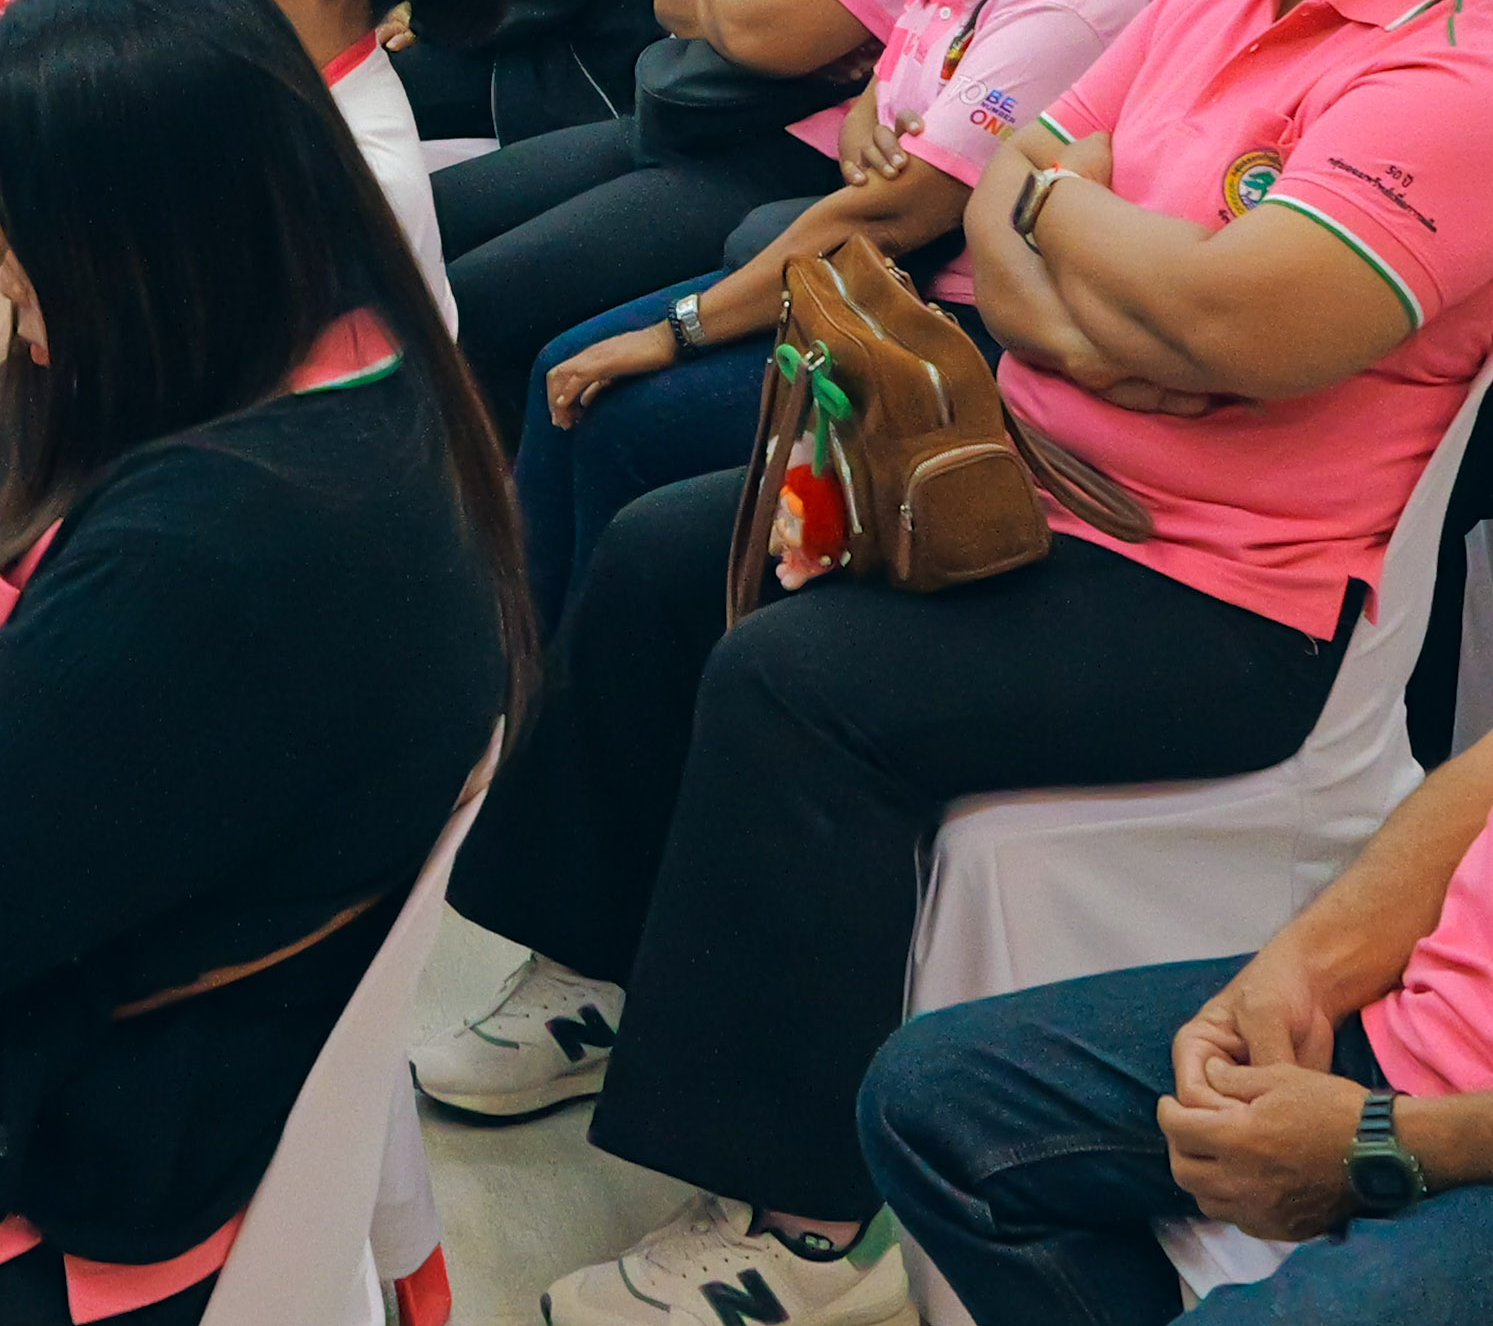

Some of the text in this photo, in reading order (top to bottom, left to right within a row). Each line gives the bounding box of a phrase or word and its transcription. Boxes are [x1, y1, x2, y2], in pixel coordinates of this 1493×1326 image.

[955, 75, 1018, 114] TO BE
[970, 109, 1016, 142] ONE
[1386, 164, 1403, 180] 50
